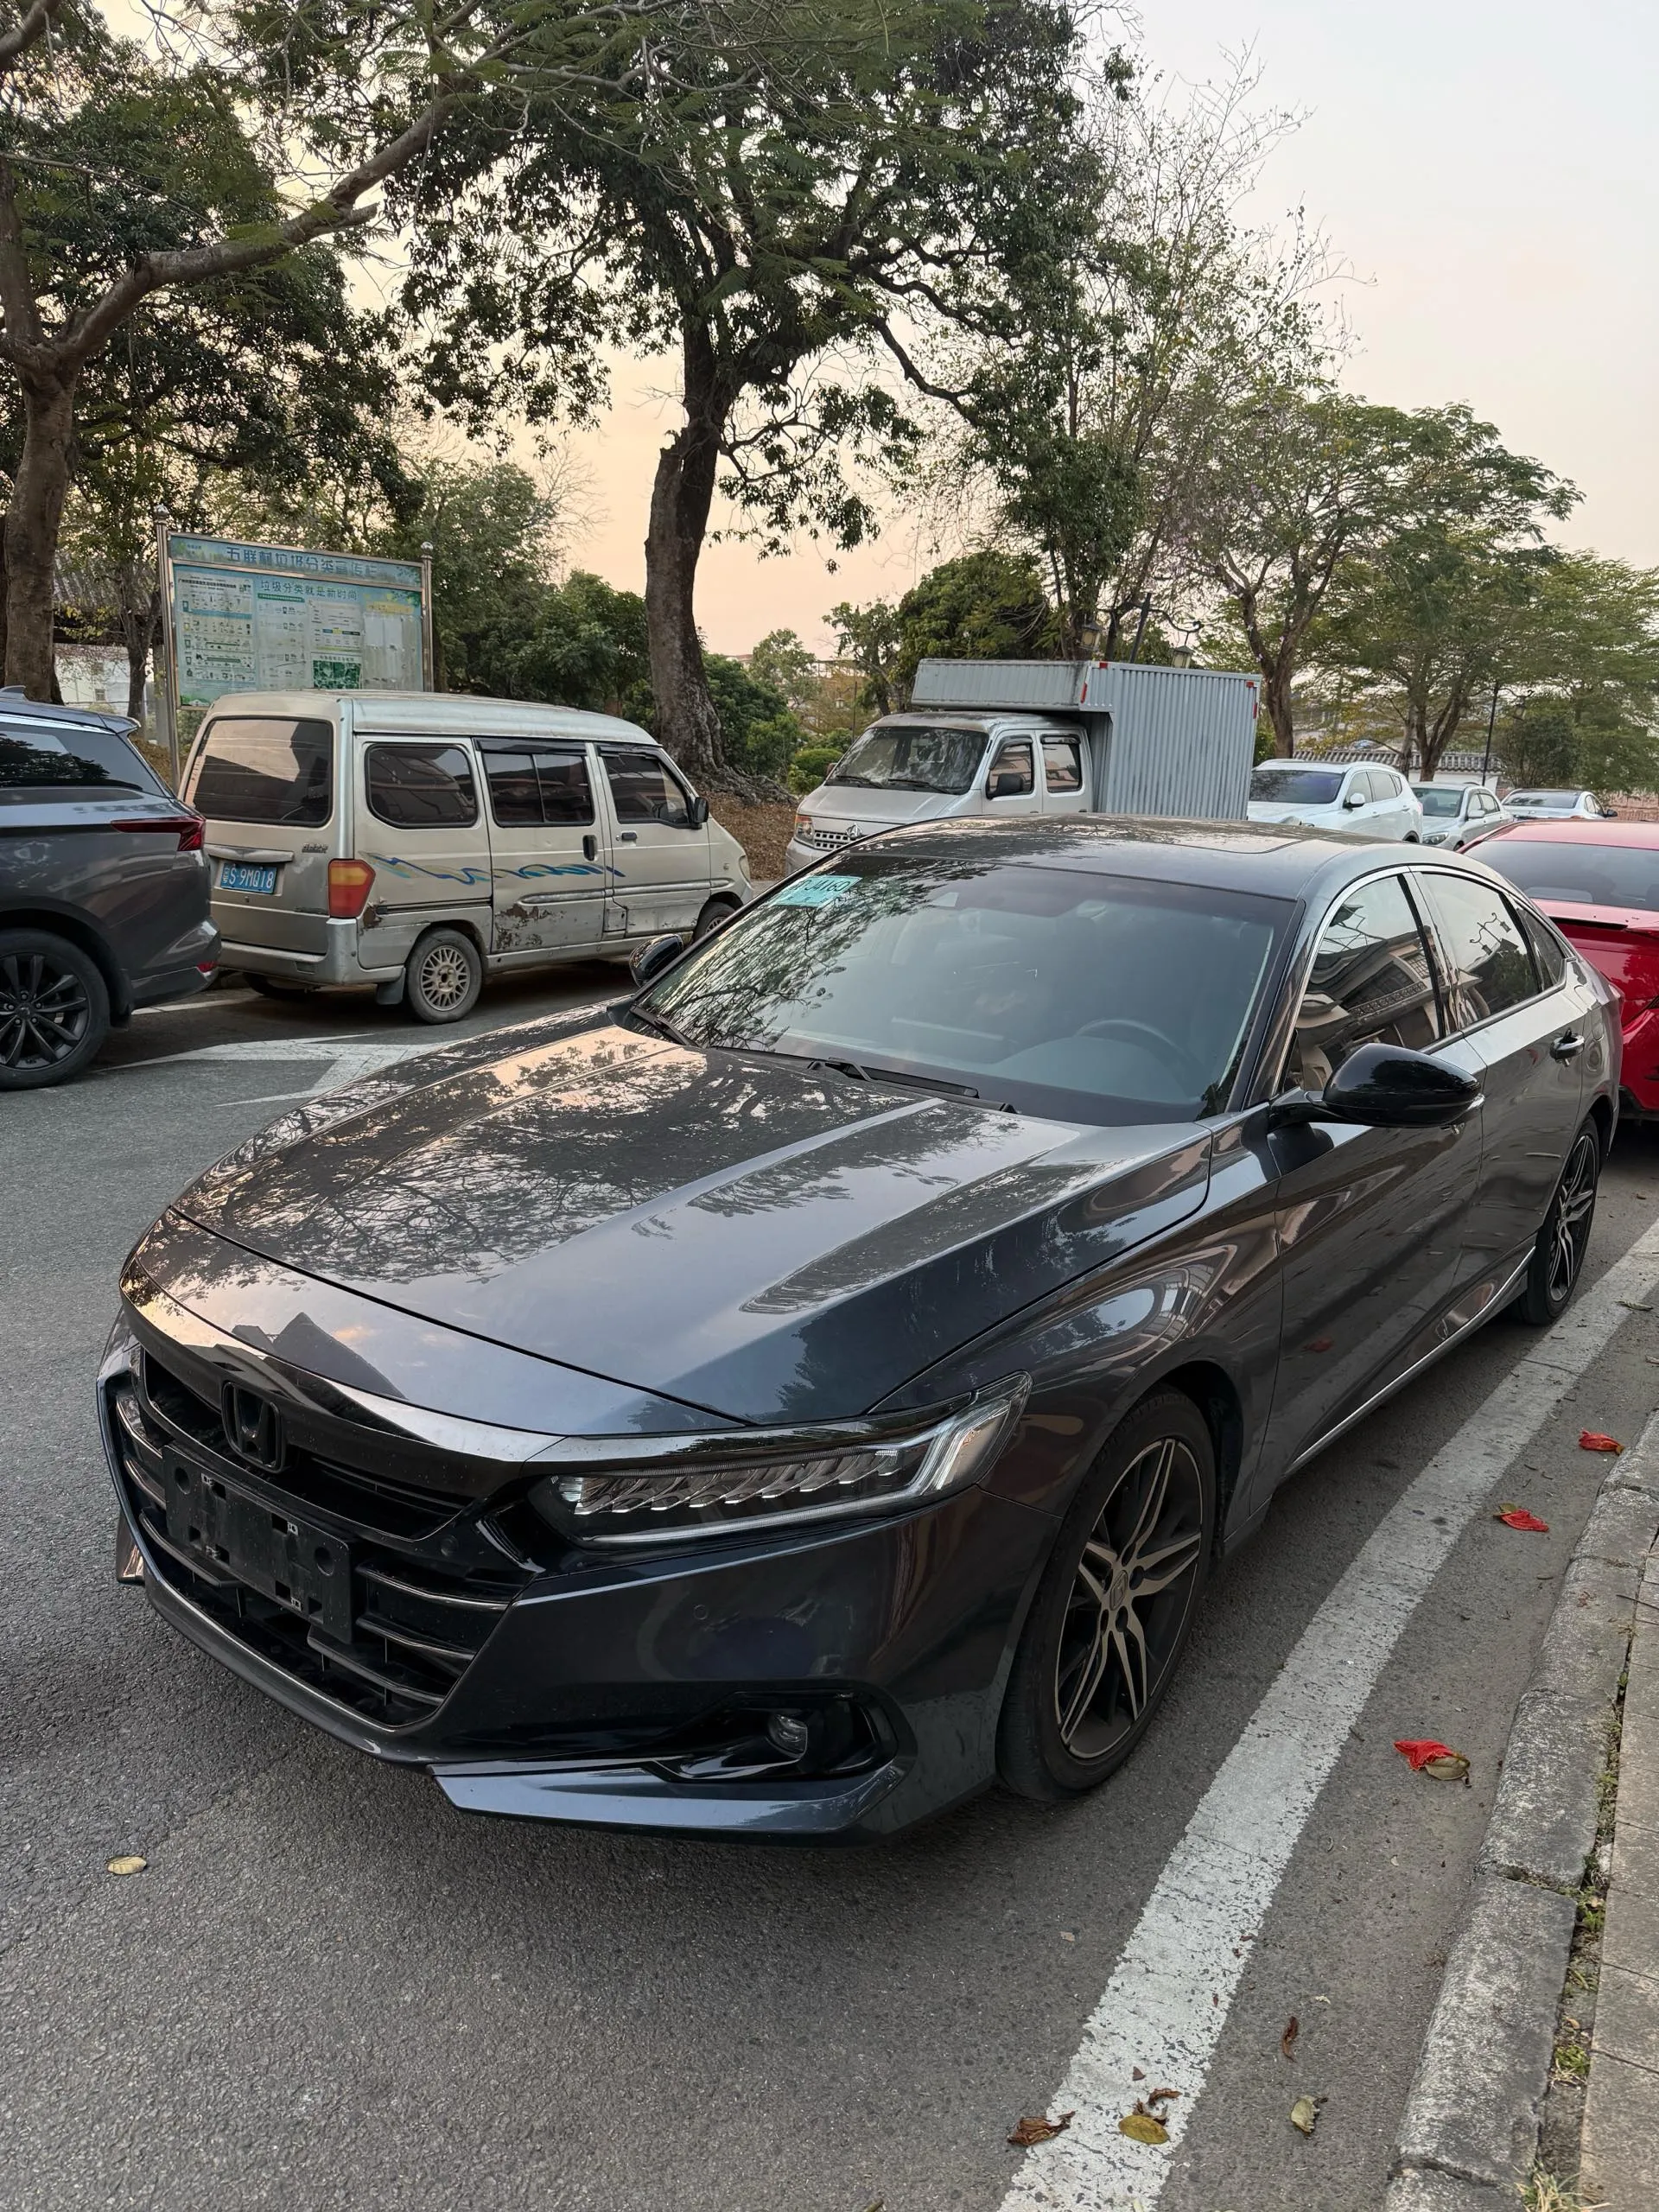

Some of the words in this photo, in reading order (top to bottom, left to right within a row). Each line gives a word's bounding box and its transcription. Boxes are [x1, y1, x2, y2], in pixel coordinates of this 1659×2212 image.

[261, 580, 358, 601] 垃圾分类就是新时尚
